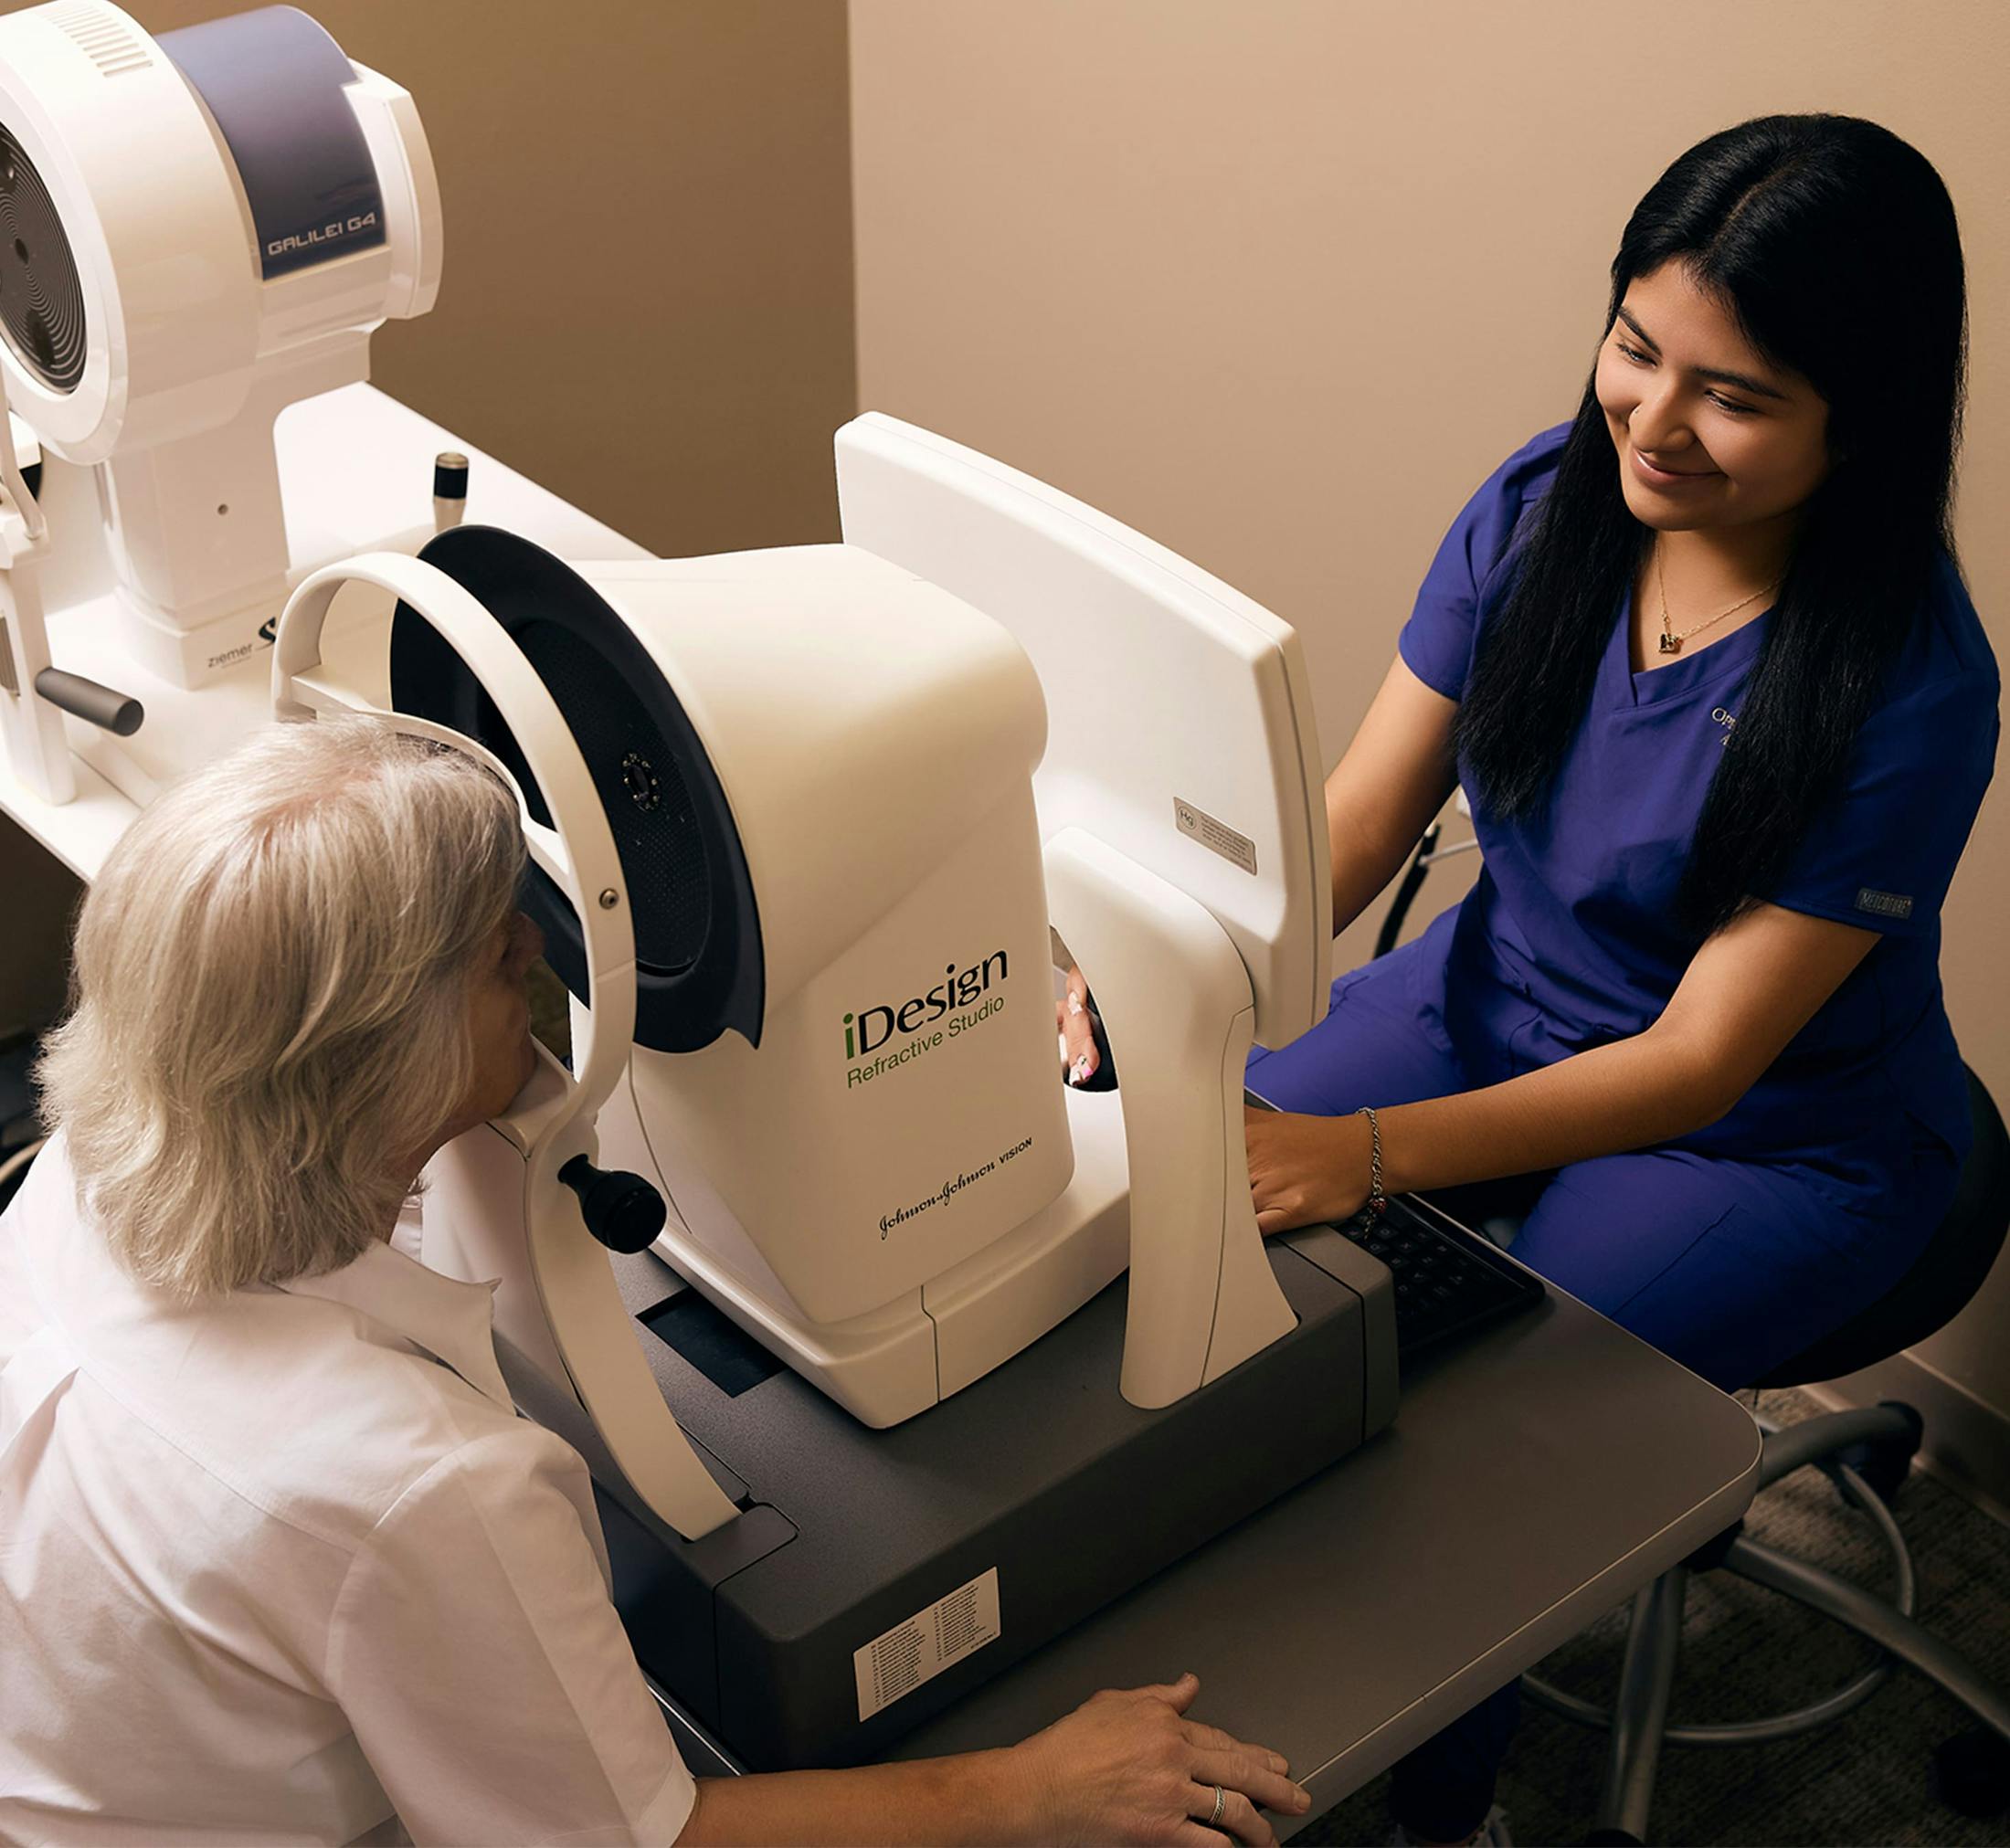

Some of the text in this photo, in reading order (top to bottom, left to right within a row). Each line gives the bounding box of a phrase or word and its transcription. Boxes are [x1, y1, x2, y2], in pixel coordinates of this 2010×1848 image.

[268, 211, 376, 256] GALILEI G4
[842, 949, 1008, 1061] iDesign
[846, 996, 1005, 1089] Refractive Studio
[998, 1136, 1032, 1166] VISION
